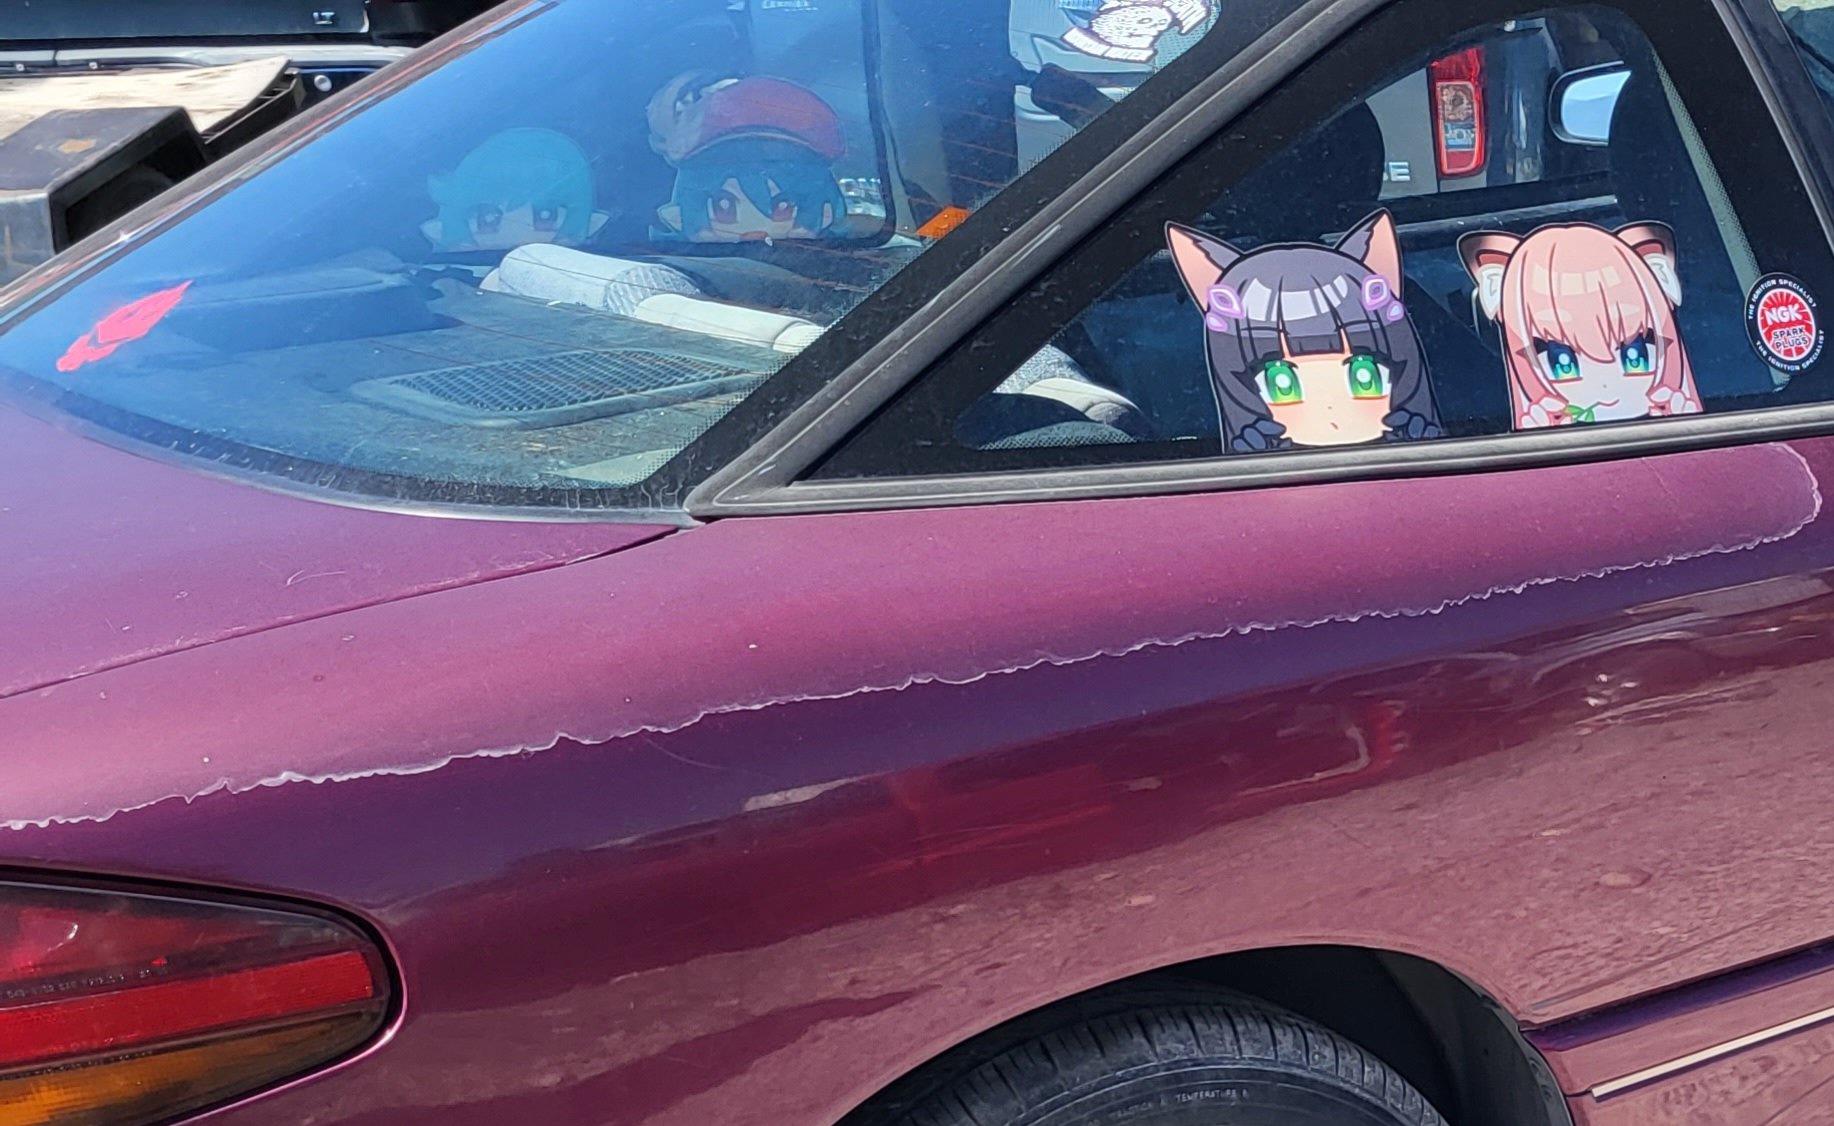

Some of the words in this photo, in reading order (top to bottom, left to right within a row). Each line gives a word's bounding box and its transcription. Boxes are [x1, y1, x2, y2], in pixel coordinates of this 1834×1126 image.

[312, 12, 335, 25] LT
[1751, 279, 1777, 303] IGNITION
[1779, 279, 1817, 308] SPECIALIST
[1764, 303, 1803, 326] NGK
[1772, 326, 1805, 339] SPARK
[1756, 340, 1768, 356] THE
[1768, 356, 1801, 371] IGNITION
[1802, 329, 1824, 370] SPECIALIST
[1775, 336, 1809, 349] PLUGS
